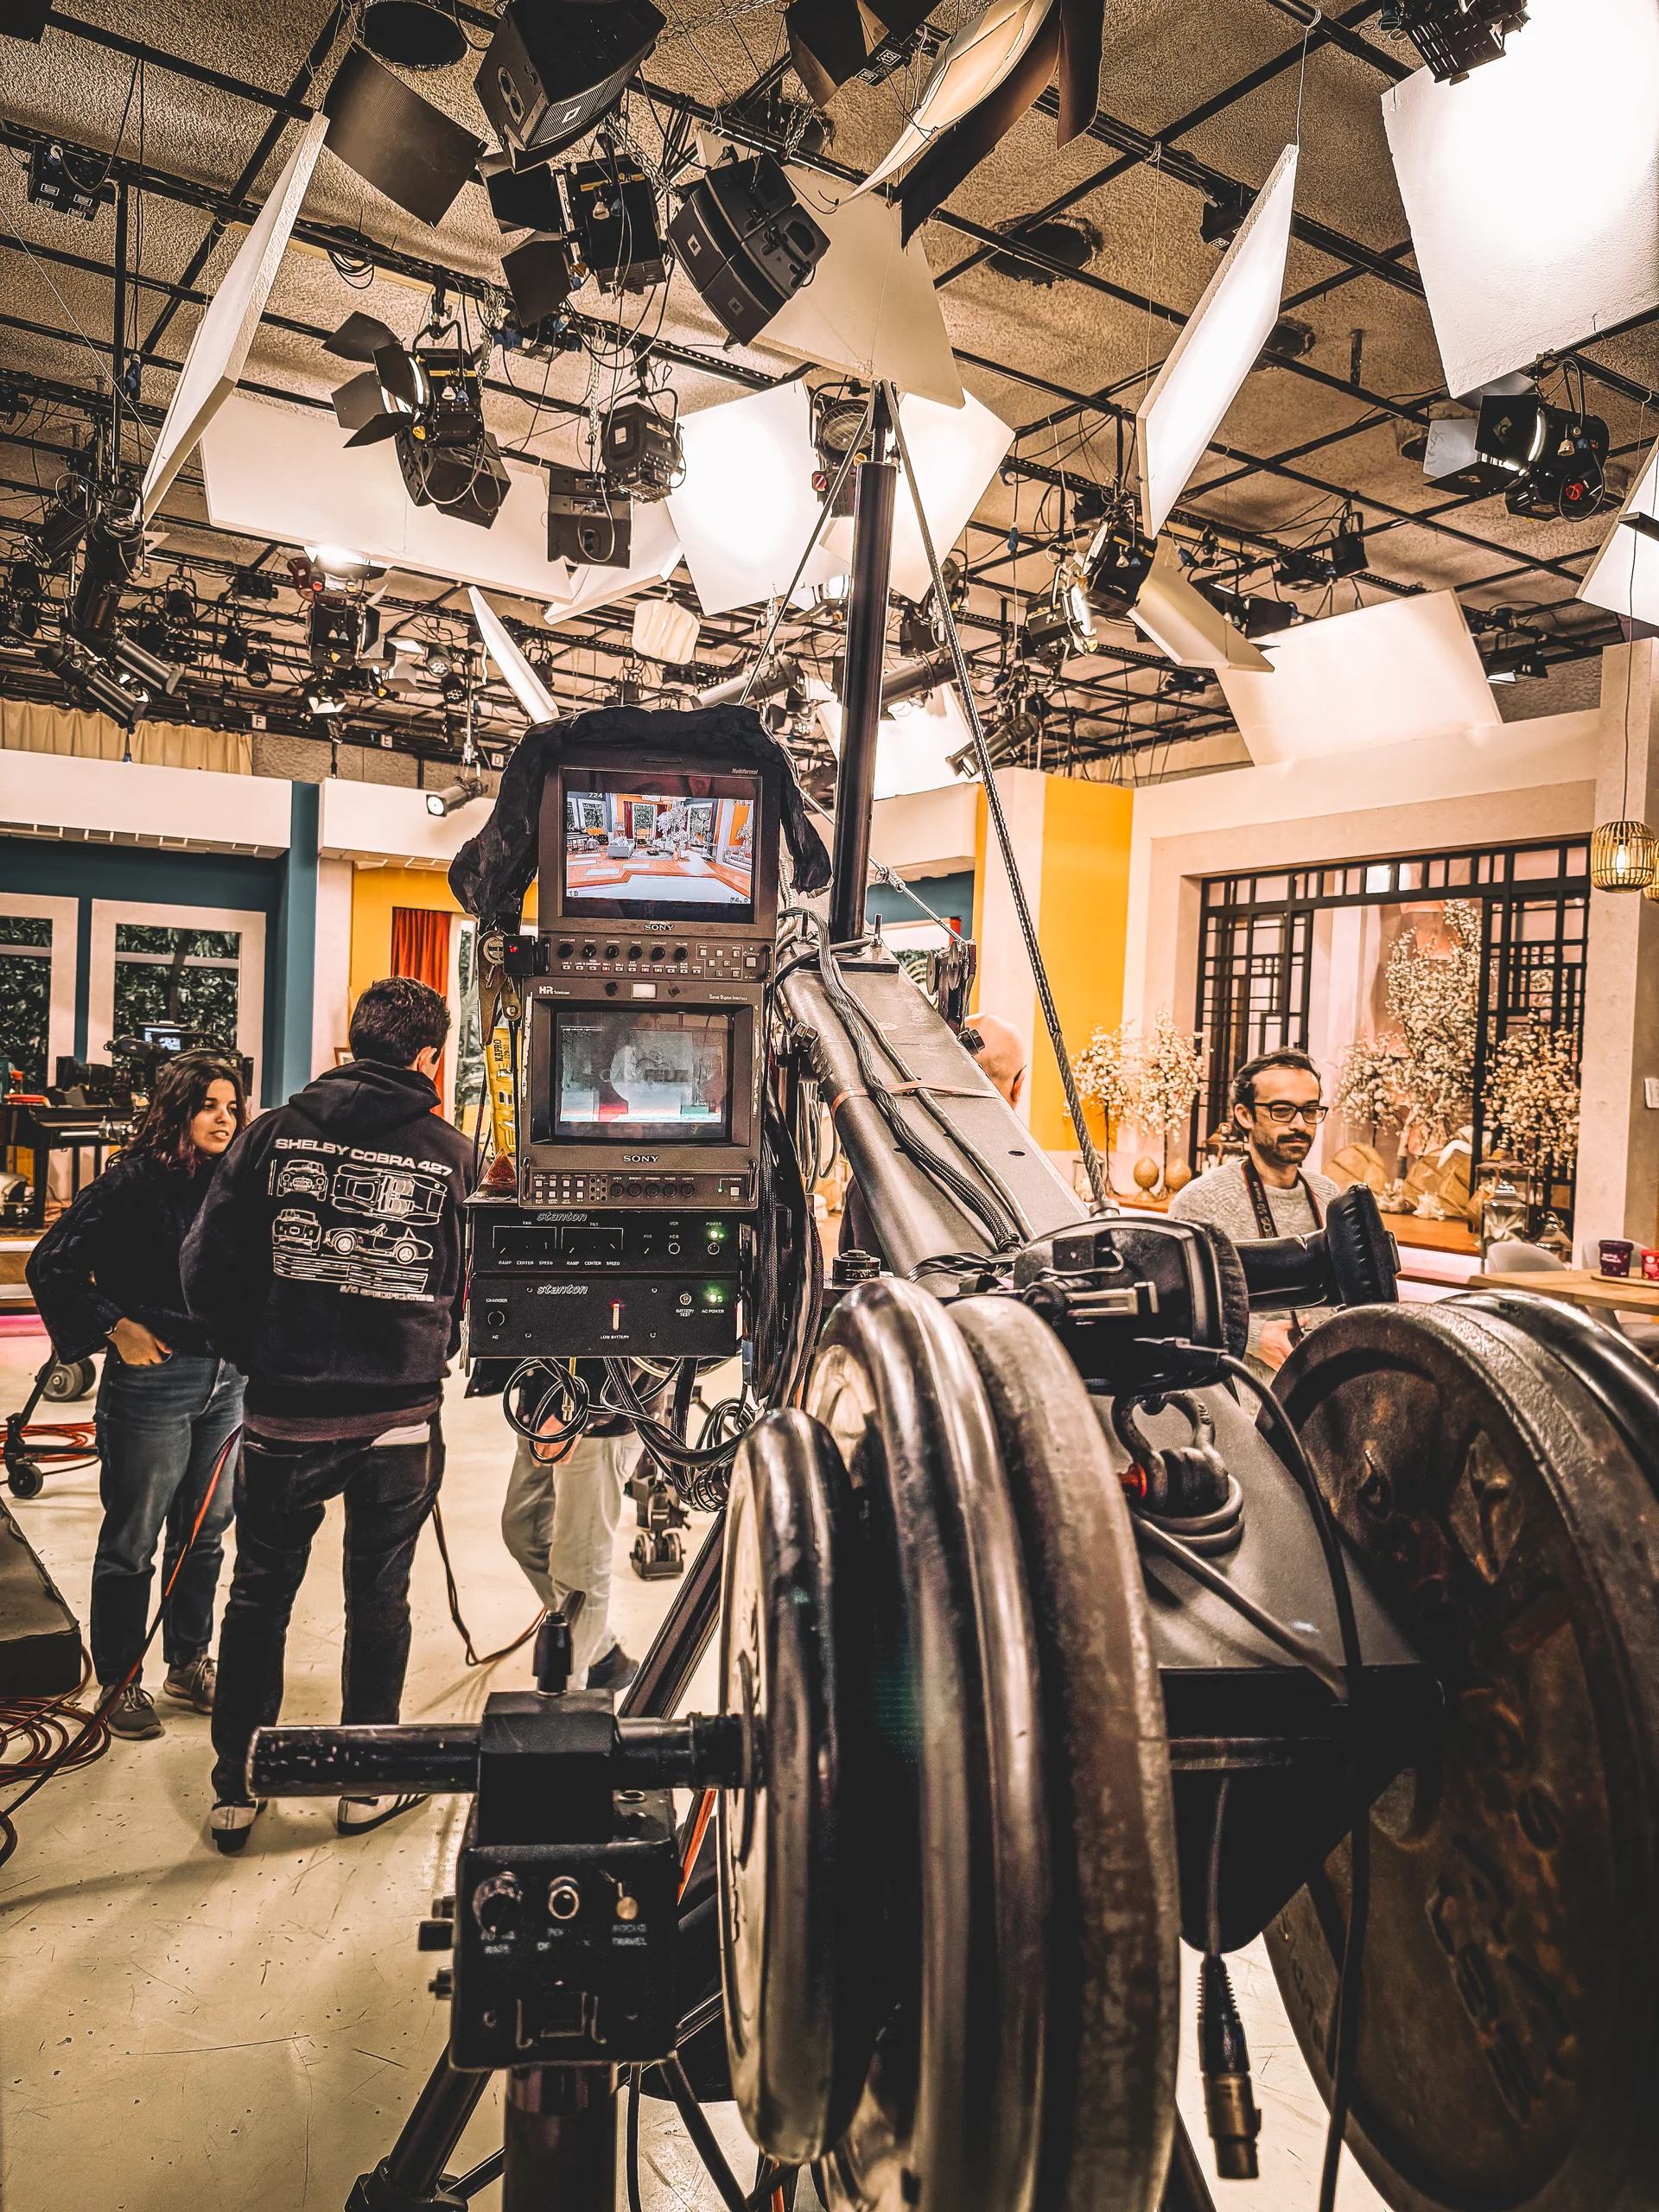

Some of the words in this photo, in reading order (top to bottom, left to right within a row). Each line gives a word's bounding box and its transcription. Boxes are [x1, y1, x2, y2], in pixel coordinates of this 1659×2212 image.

[880, 51, 898, 63] 132
[858, 70, 874, 82] 130
[644, 923, 674, 931] SONY
[538, 986, 554, 995] HR
[493, 1039, 504, 1062] KAPRO
[275, 1138, 351, 1156] SHELBY
[349, 1148, 416, 1169] COBRA
[416, 1160, 454, 1177] 427
[622, 1154, 659, 1163] SONY
[536, 1211, 588, 1222] stanton
[537, 1283, 588, 1294] stanton
